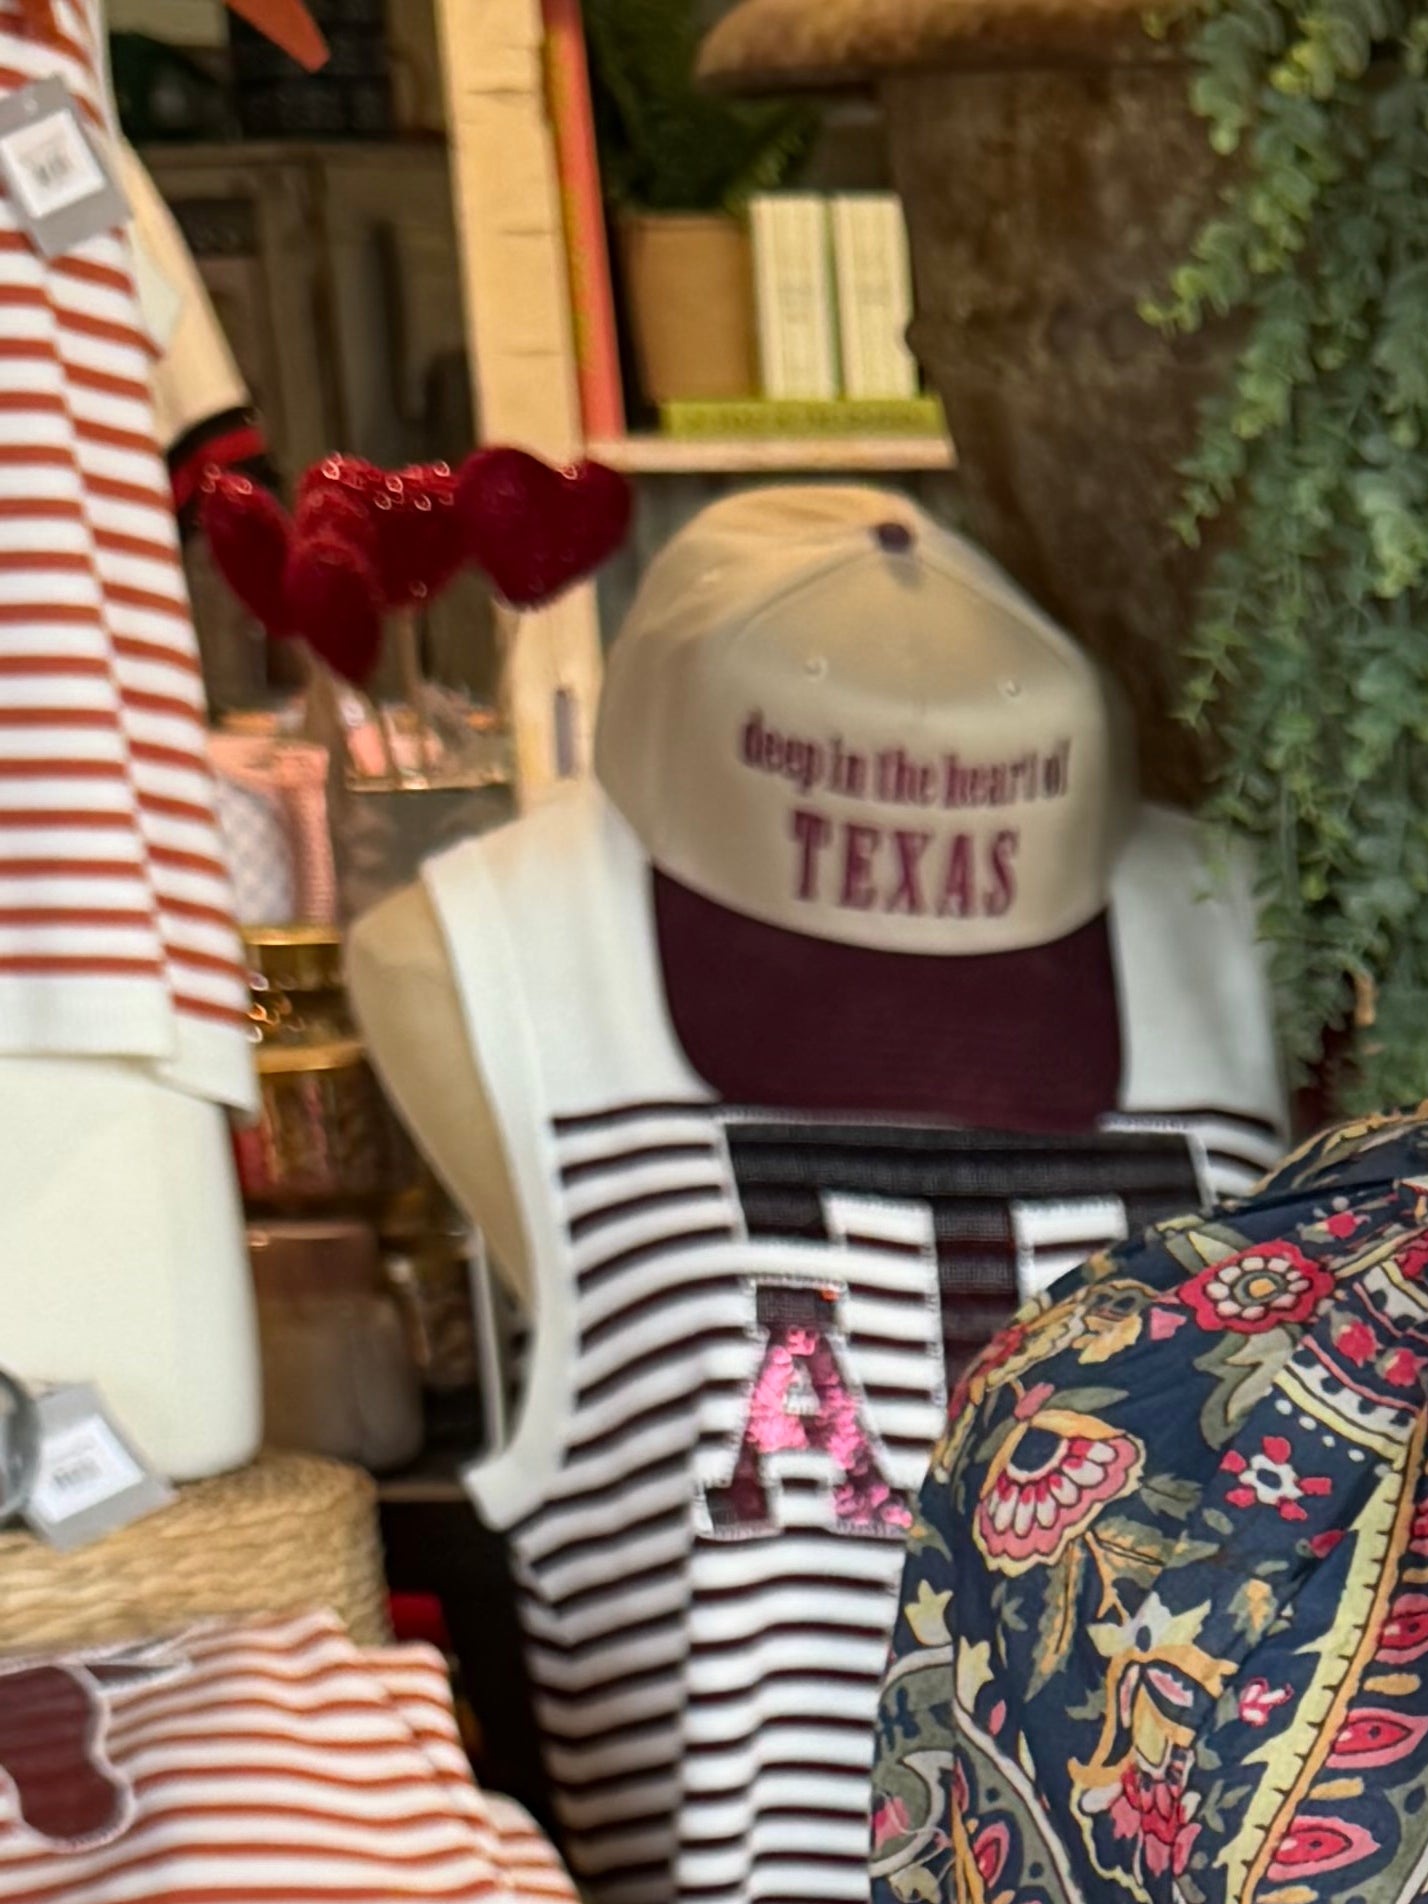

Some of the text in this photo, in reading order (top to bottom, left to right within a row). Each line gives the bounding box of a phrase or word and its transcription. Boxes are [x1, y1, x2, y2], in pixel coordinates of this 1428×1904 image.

[742, 708, 1072, 809] deep in the heart of
[789, 808, 1020, 918] TEXAS
